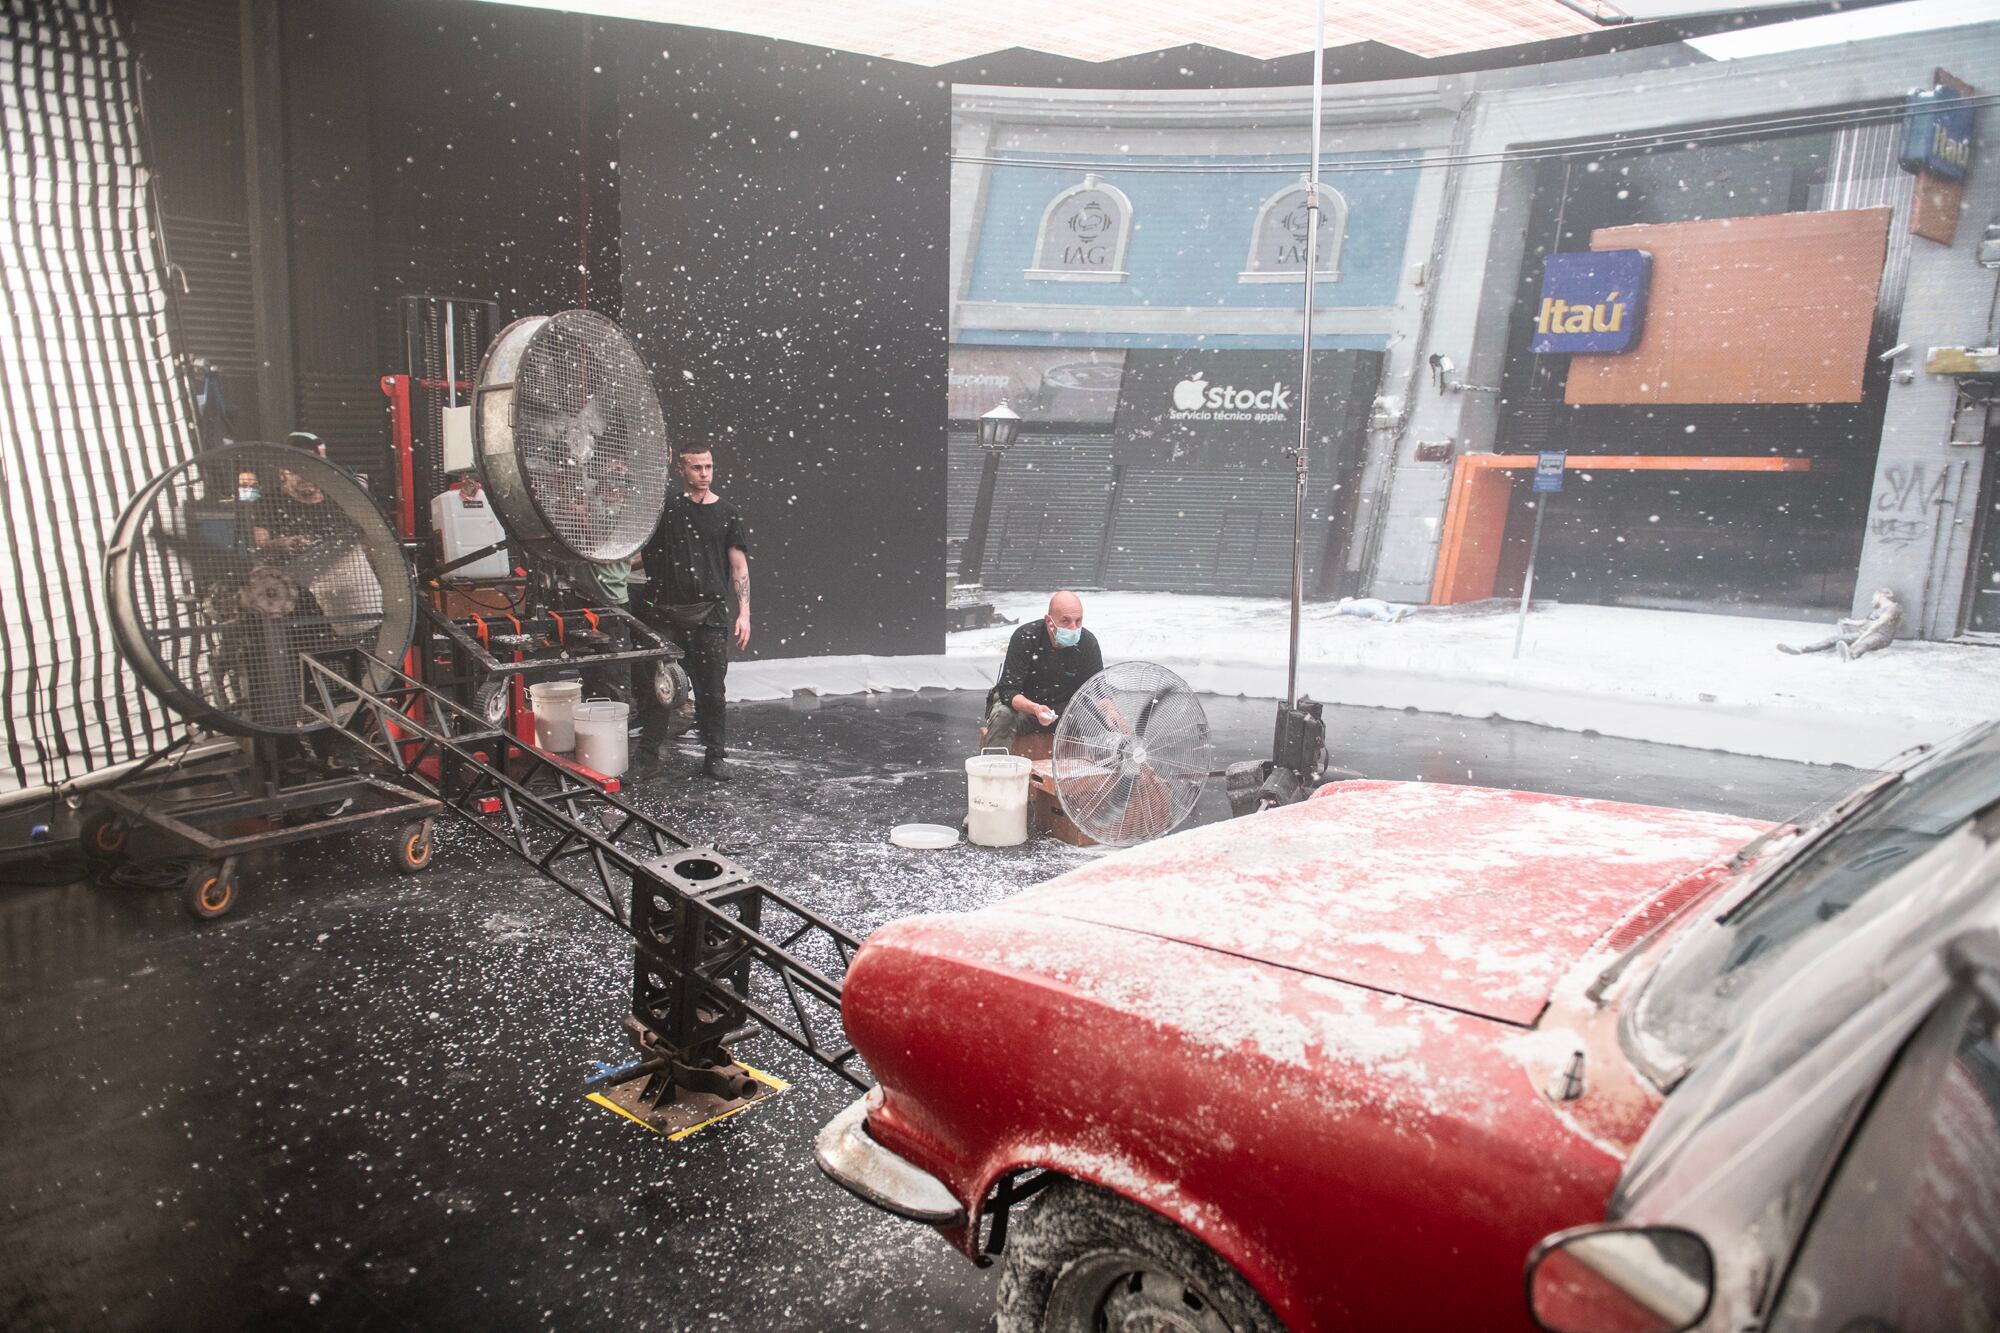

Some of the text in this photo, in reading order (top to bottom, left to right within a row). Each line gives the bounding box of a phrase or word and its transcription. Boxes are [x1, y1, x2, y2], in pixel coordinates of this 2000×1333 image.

[1932, 122, 1969, 167] Itaú
[1064, 246, 1106, 265] IAG
[1538, 291, 1626, 334] Itaú
[1206, 381, 1291, 410] stock
[1169, 409, 1212, 420] Servicio
[1213, 409, 1252, 421] técnico
